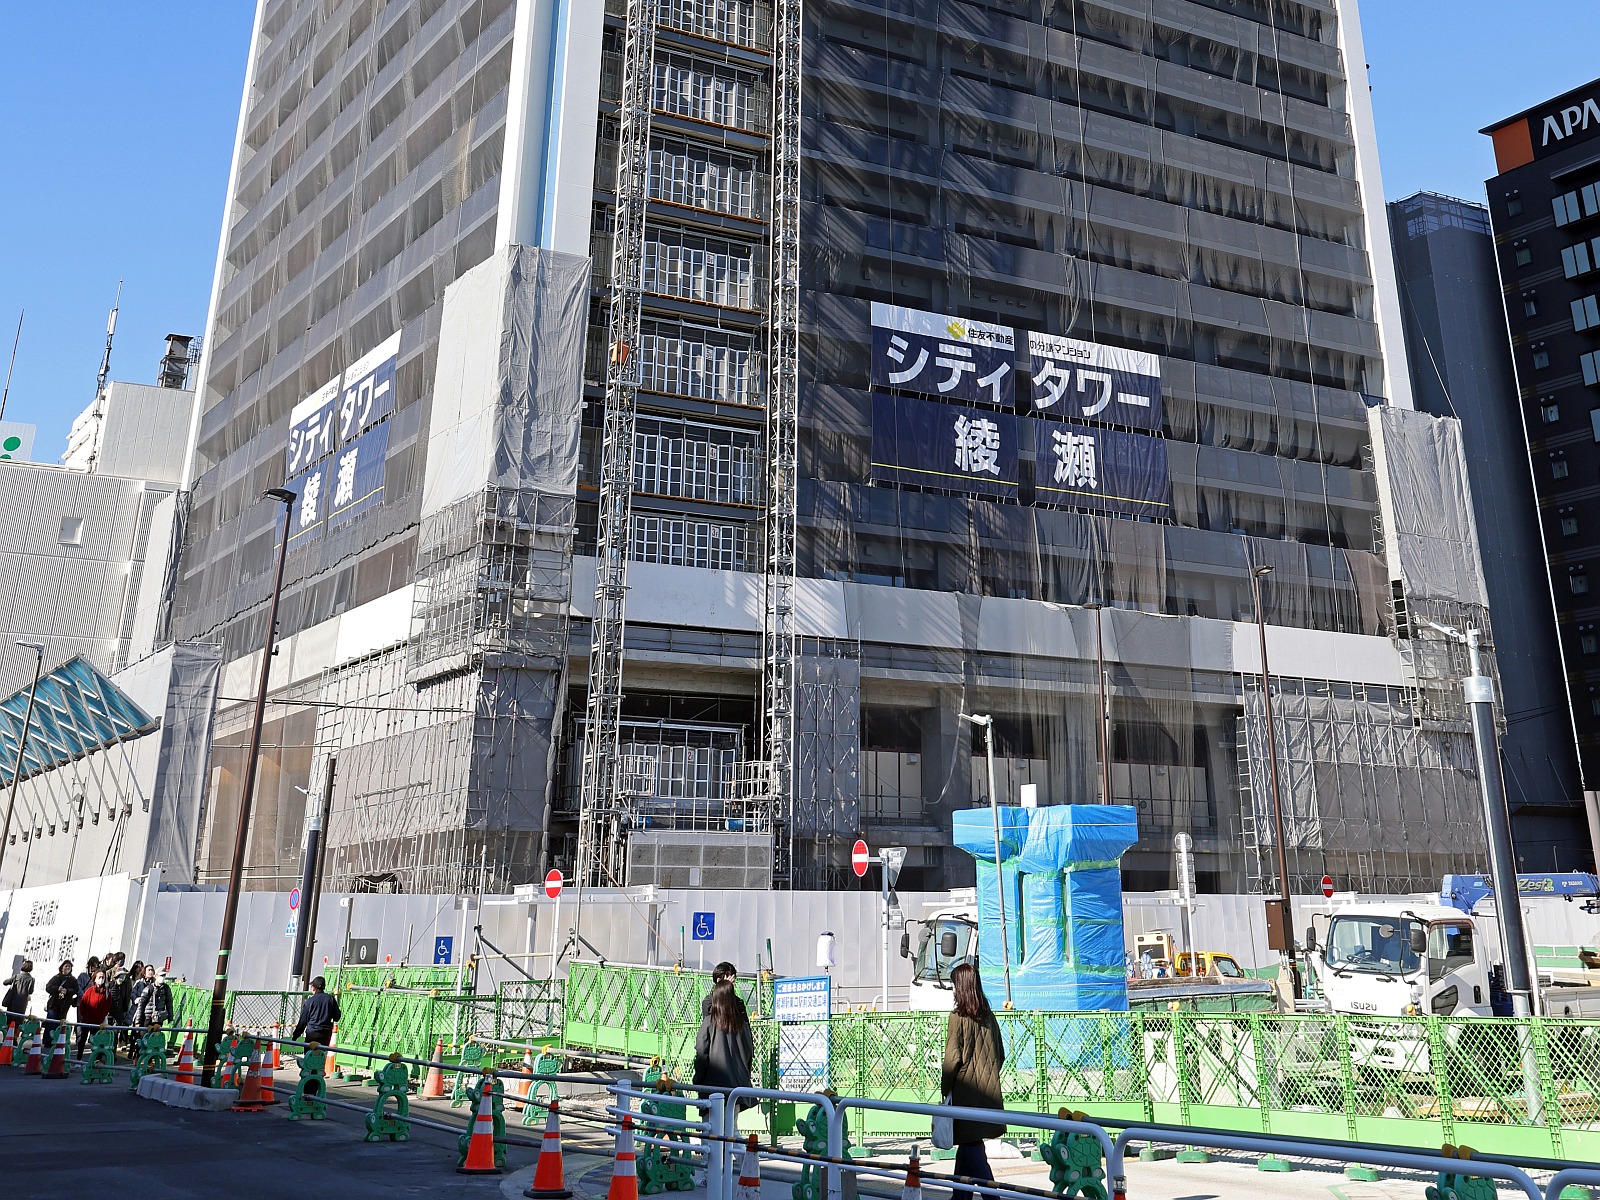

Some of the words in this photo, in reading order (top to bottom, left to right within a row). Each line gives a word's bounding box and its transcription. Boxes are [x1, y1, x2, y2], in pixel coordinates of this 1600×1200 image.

[1542, 98, 1600, 146] APA
[968, 328, 1014, 346] 住友不動産
[1030, 340, 1091, 359] の分譲マンション
[1350, 1001, 1378, 1012] ISUZU
